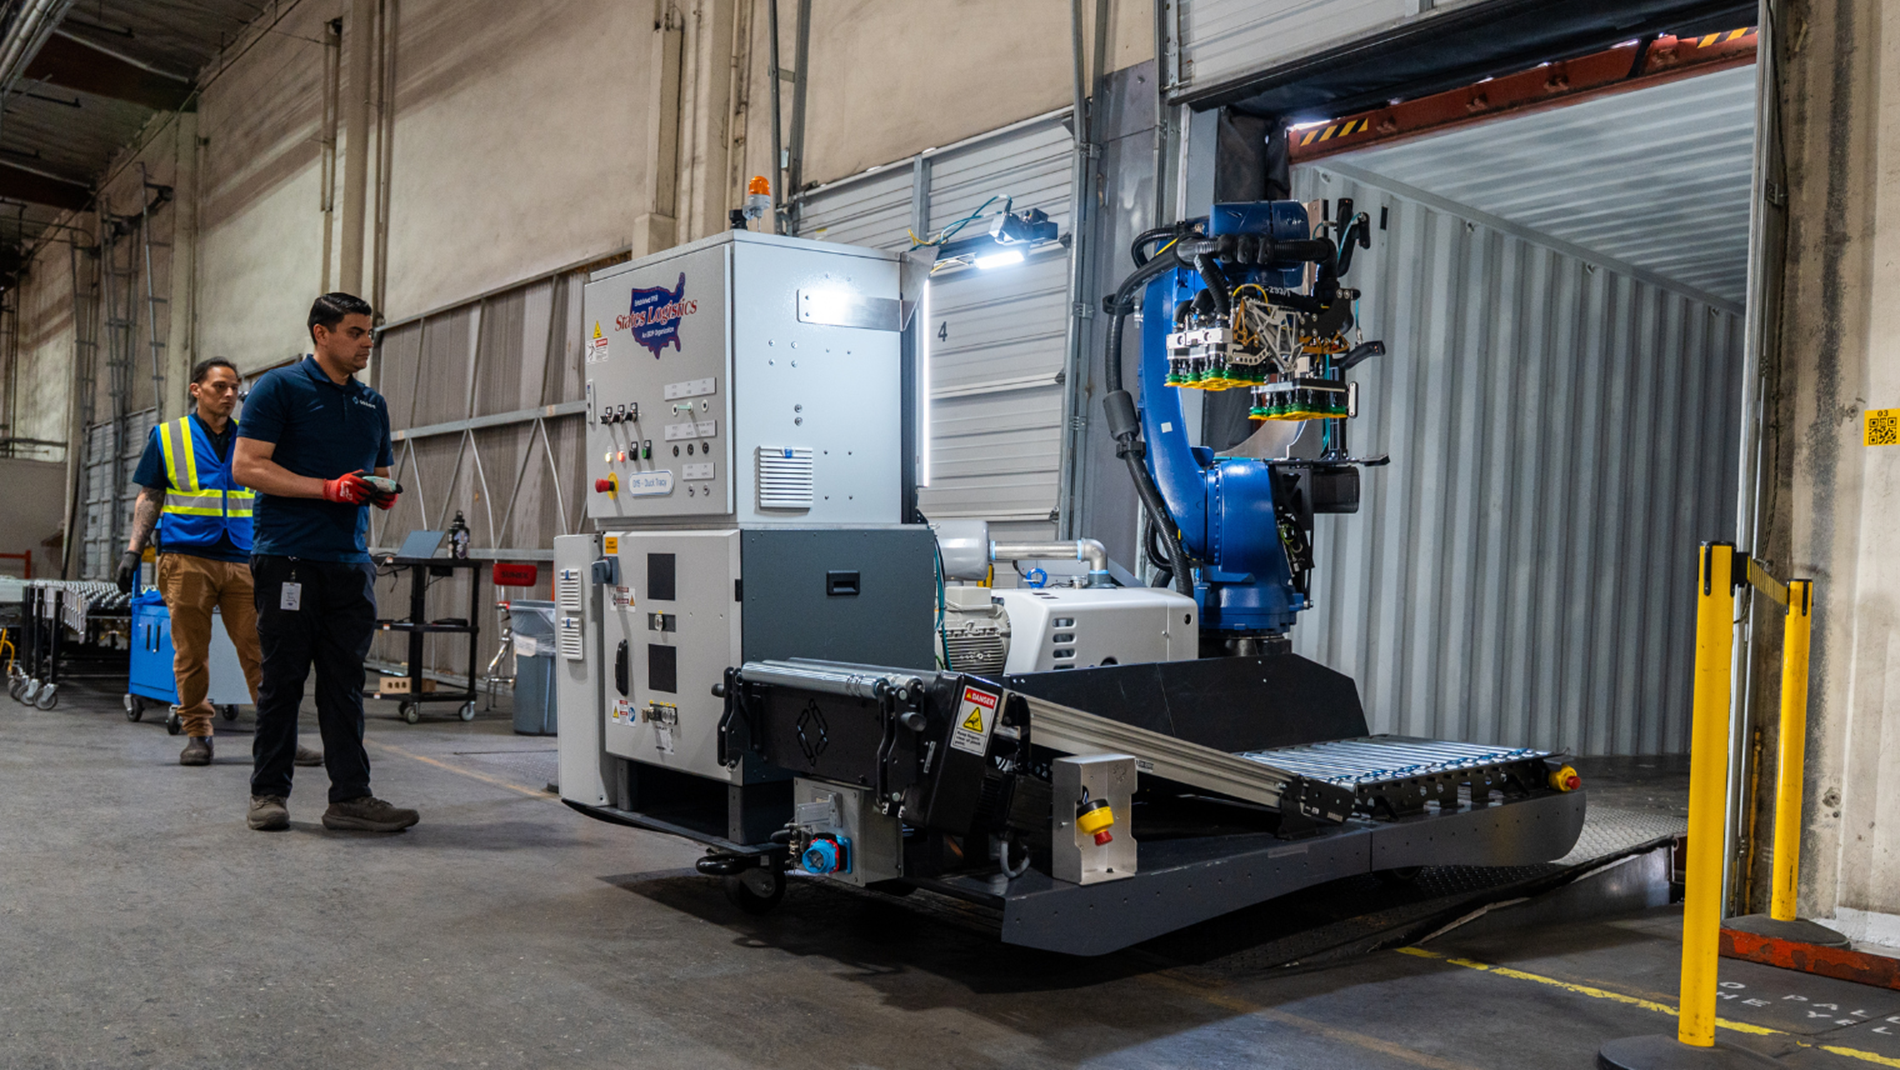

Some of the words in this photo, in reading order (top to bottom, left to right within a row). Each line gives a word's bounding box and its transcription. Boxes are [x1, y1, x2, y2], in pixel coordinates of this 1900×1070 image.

[615, 310, 647, 332] States
[646, 298, 698, 326] Logistics
[937, 320, 948, 342] 4
[972, 693, 994, 706] DANGER
